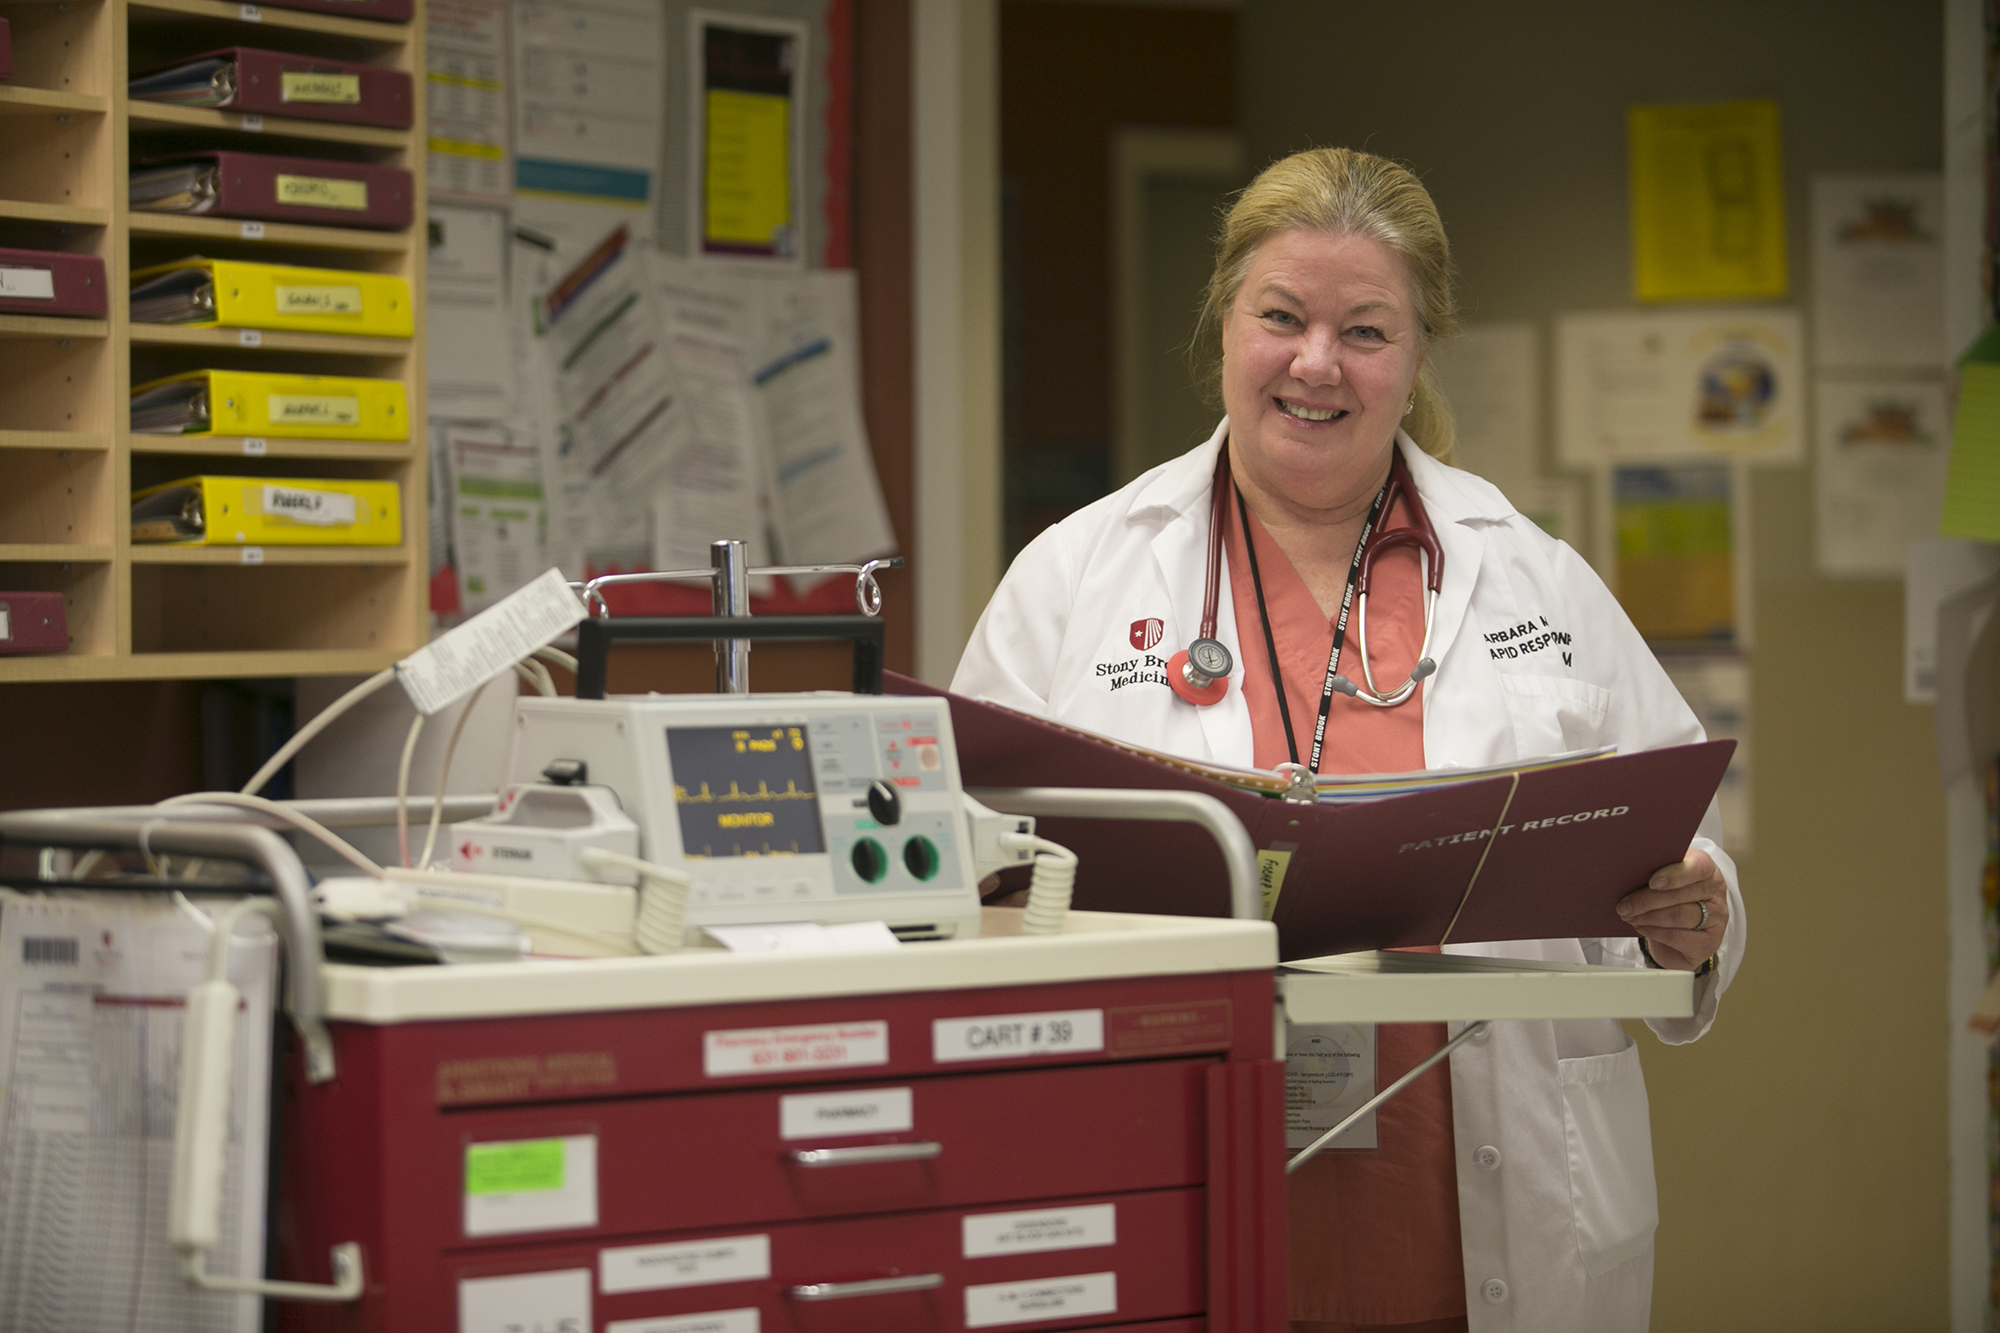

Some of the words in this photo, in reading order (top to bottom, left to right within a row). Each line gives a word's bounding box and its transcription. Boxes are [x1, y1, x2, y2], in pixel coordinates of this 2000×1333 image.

[1353, 544, 1365, 568] STONY
[1360, 522, 1372, 549] BROOK
[1343, 583, 1354, 608] BROOK
[1338, 607, 1349, 631] STONY
[1483, 620, 1538, 643] ARBARA
[1329, 647, 1340, 672] BROOK
[1490, 646, 1519, 660] APID
[1096, 658, 1139, 677] Stony
[1110, 671, 1173, 692] Medicin
[1324, 672, 1335, 697] STONY
[1315, 714, 1326, 741] BROOK
[1310, 742, 1321, 768] STONY
[718, 812, 774, 829] MONITOR
[1399, 825, 1515, 853] PATIENT
[1522, 805, 1630, 832] RECORD
[966, 1023, 1024, 1049] CART
[1031, 1023, 1043, 1044] #
[1047, 1020, 1074, 1044] 39
